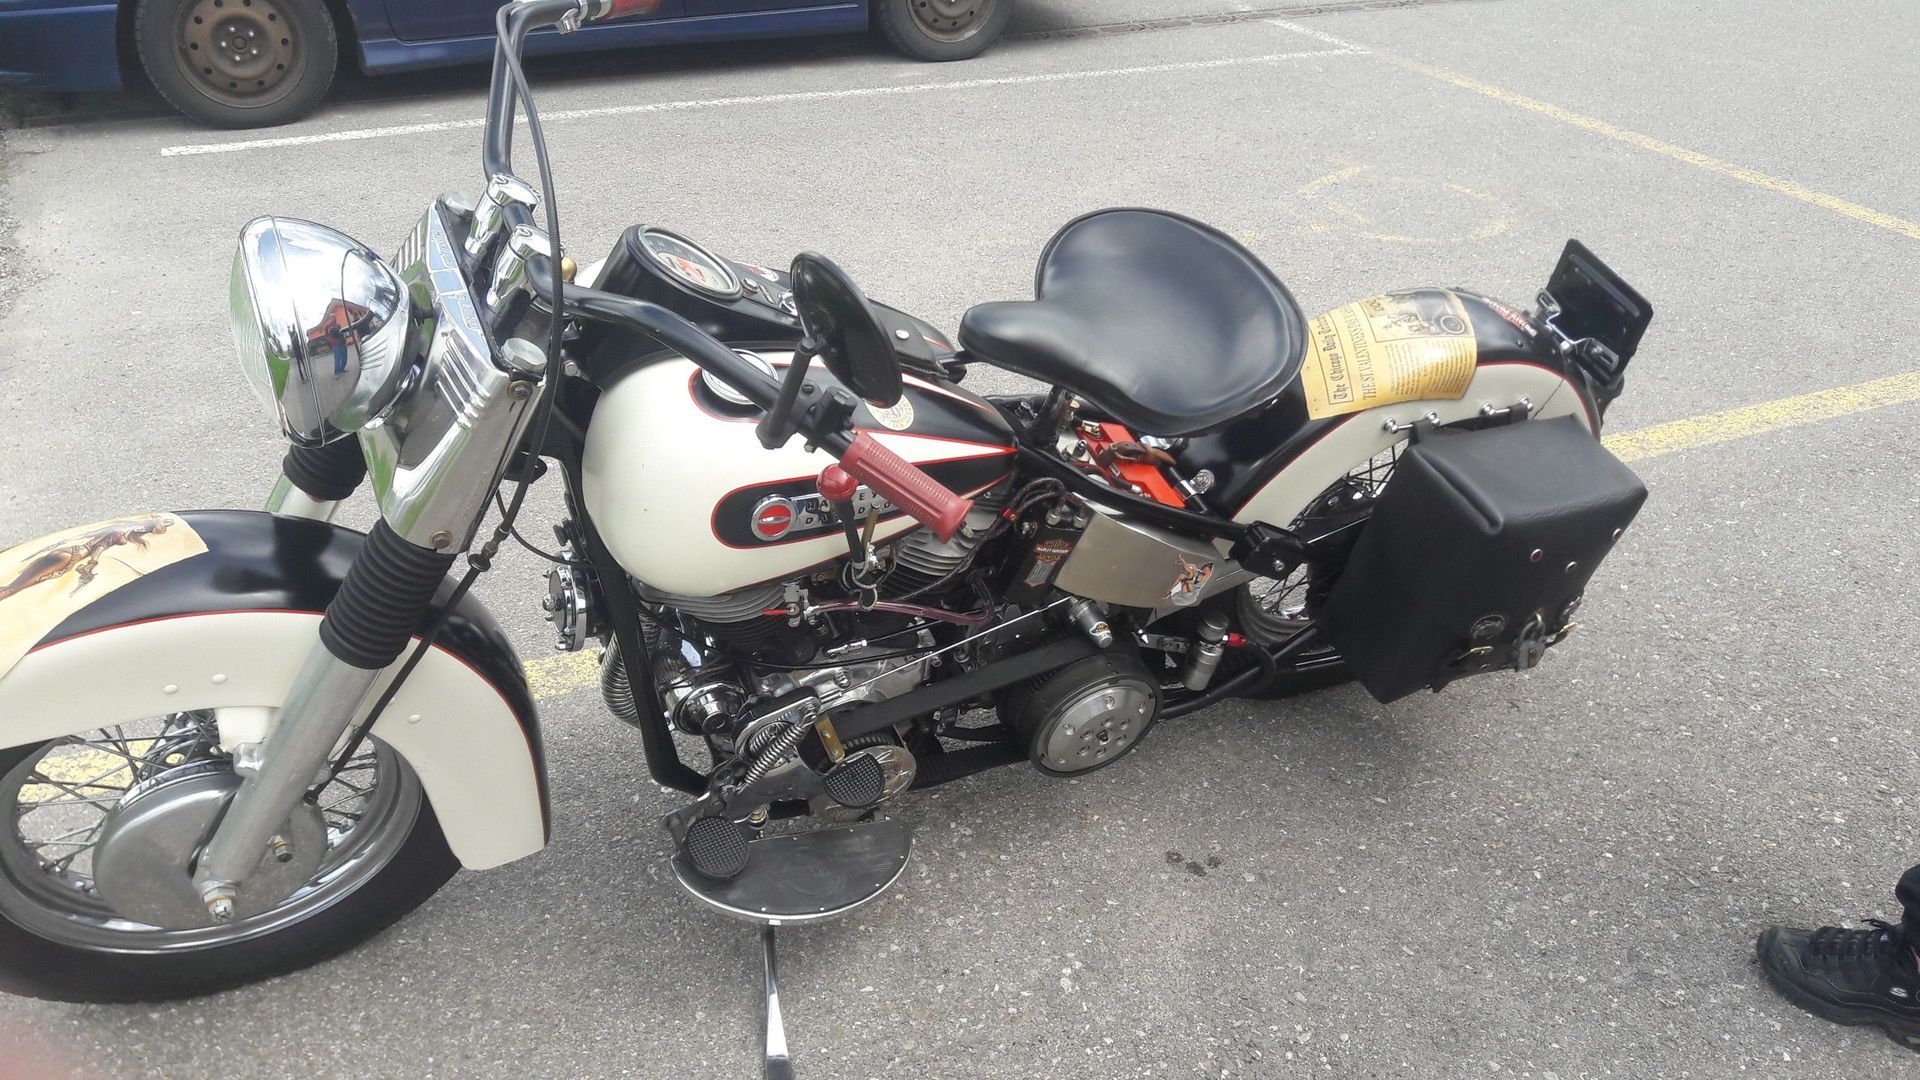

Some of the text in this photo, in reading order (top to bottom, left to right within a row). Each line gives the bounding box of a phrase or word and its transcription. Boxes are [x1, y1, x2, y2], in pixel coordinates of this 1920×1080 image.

[1329, 353, 1345, 382] Chicago
[1333, 383, 1350, 400] The
[1362, 383, 1377, 400] THE
[806, 490, 878, 511] HAEY
